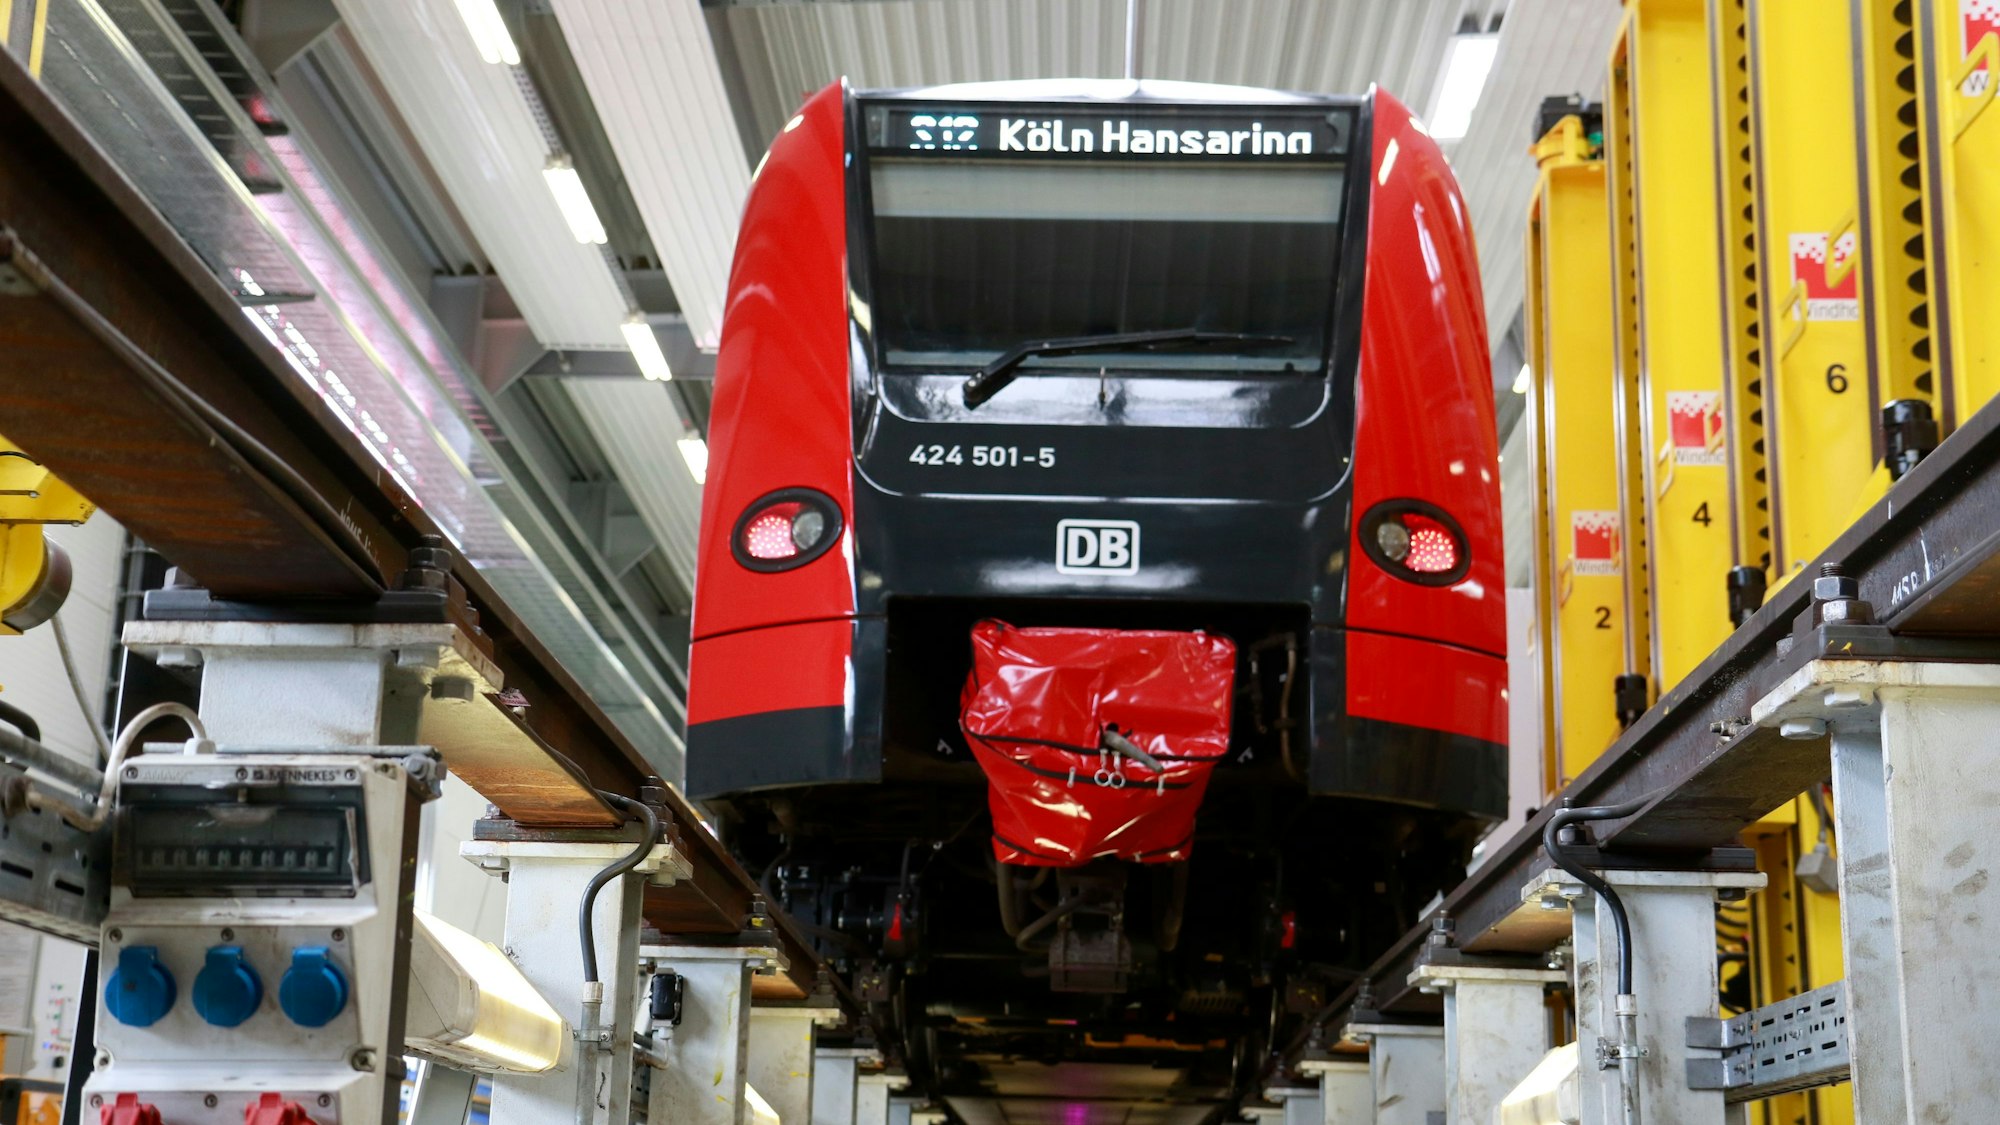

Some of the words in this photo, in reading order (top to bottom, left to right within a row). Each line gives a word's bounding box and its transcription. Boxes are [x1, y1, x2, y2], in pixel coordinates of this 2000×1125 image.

[998, 118, 1094, 153] Köln
[1826, 363, 1849, 394] 6
[909, 444, 963, 466] 424
[972, 446, 1056, 468] 501-5
[1692, 501, 1713, 528] 4
[1064, 525, 1132, 569] DB
[1595, 606, 1612, 629] 2
